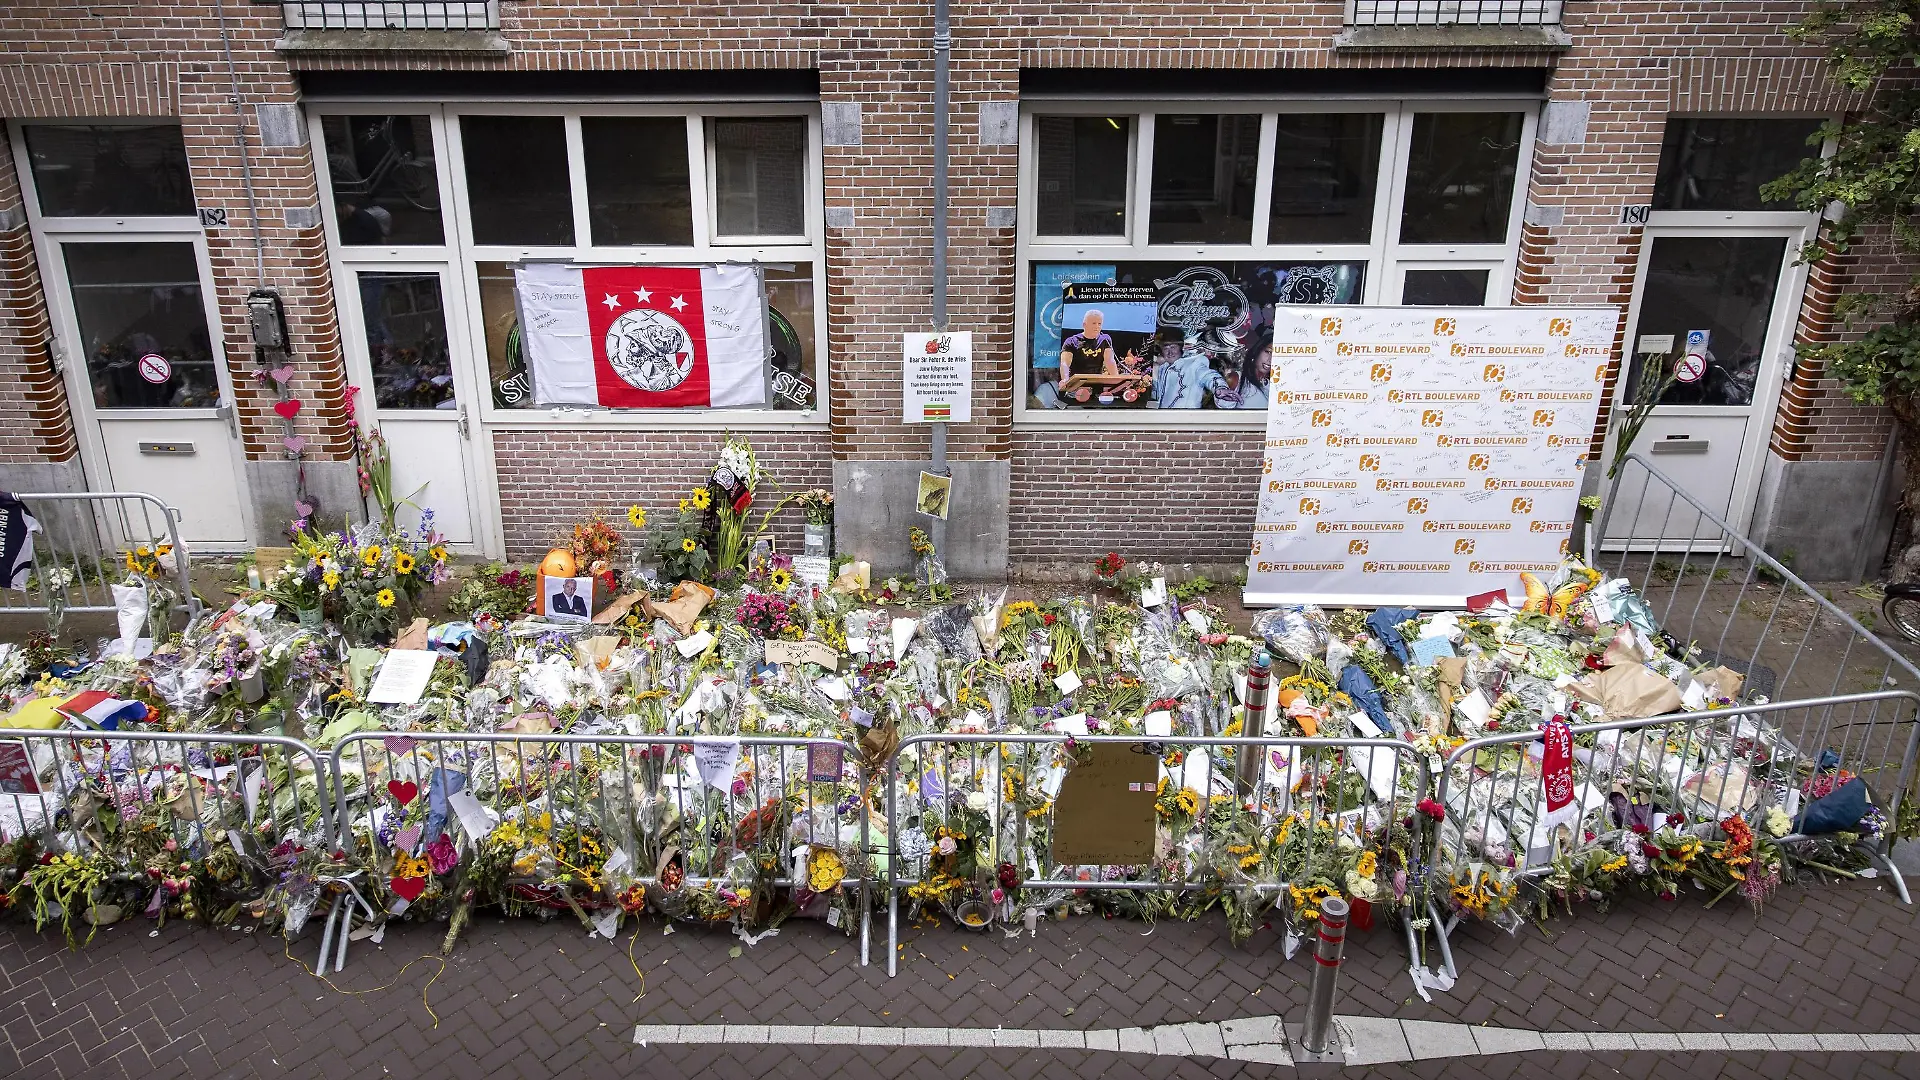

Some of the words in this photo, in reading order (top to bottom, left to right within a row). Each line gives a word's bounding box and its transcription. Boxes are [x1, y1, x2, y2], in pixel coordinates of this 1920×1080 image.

[199, 208, 227, 225] 182
[1621, 205, 1650, 223] 180
[711, 305, 731, 316] STAY
[710, 319, 740, 333] STRONG
[1354, 345, 1372, 354] RTL
[1374, 345, 1430, 354] BOULEVARD
[1467, 346, 1485, 355] RTL
[1488, 346, 1544, 354] BOULEVARD
[1582, 347, 1599, 355] RTL
[1294, 393, 1311, 401] RTL
[1313, 392, 1368, 400] BOULEVARD
[1404, 392, 1422, 400] RTL
[1425, 392, 1480, 400] BOULEVARD
[1517, 392, 1534, 400] RTL
[1536, 392, 1592, 400] BOULEVARD
[1343, 437, 1360, 445] RTL
[1363, 437, 1418, 445] BOULEVARD
[1453, 437, 1470, 445] RTL
[1473, 437, 1528, 445] BOULEVARD
[1564, 437, 1581, 445] RTL
[1284, 481, 1301, 489] RTL
[1303, 481, 1357, 489] BOULEVARD
[1392, 481, 1409, 489] RTL
[1501, 480, 1518, 488] RTL
[1520, 480, 1574, 488] BOULEVARD
[1332, 523, 1348, 531] RTL
[1351, 523, 1404, 531] BOULEVARD
[1546, 523, 1563, 531] RTL
[1292, 563, 1344, 571] BOULEVARD
[1378, 563, 1395, 571] RTL
[1397, 563, 1450, 571] BOULEVARD
[1485, 563, 1501, 571] RTL
[1503, 563, 1557, 571] BOULEVARD
